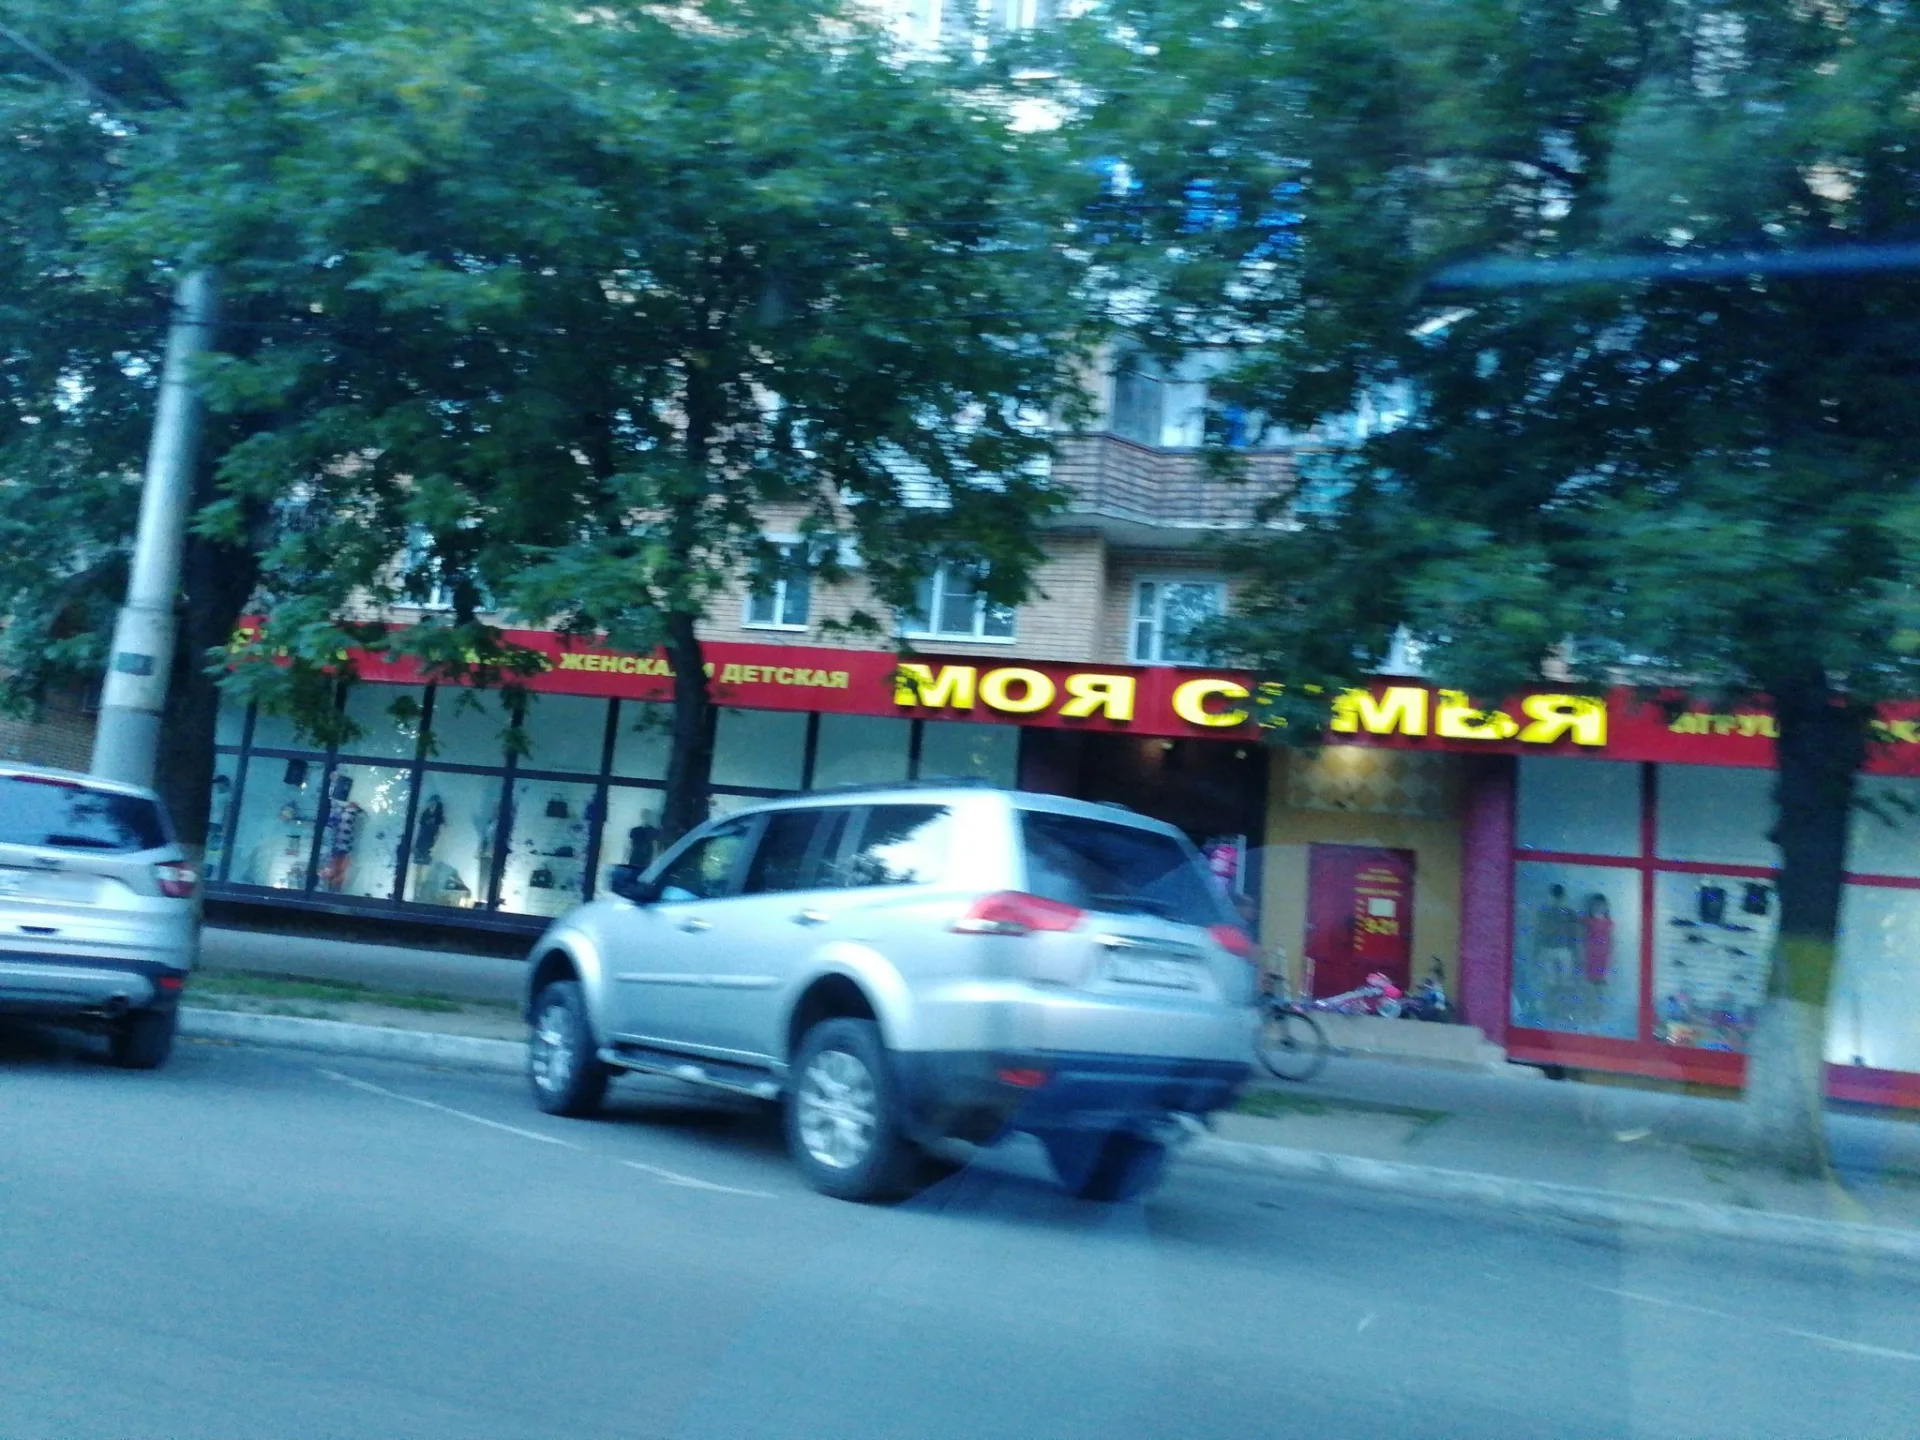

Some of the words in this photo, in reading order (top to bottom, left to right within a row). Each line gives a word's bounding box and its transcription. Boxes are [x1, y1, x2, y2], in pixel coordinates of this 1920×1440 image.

[559, 652, 678, 677] ЖЕНСКА
[719, 663, 849, 689] ДЕТСКАЯ
[893, 663, 1137, 721] МОЯ
